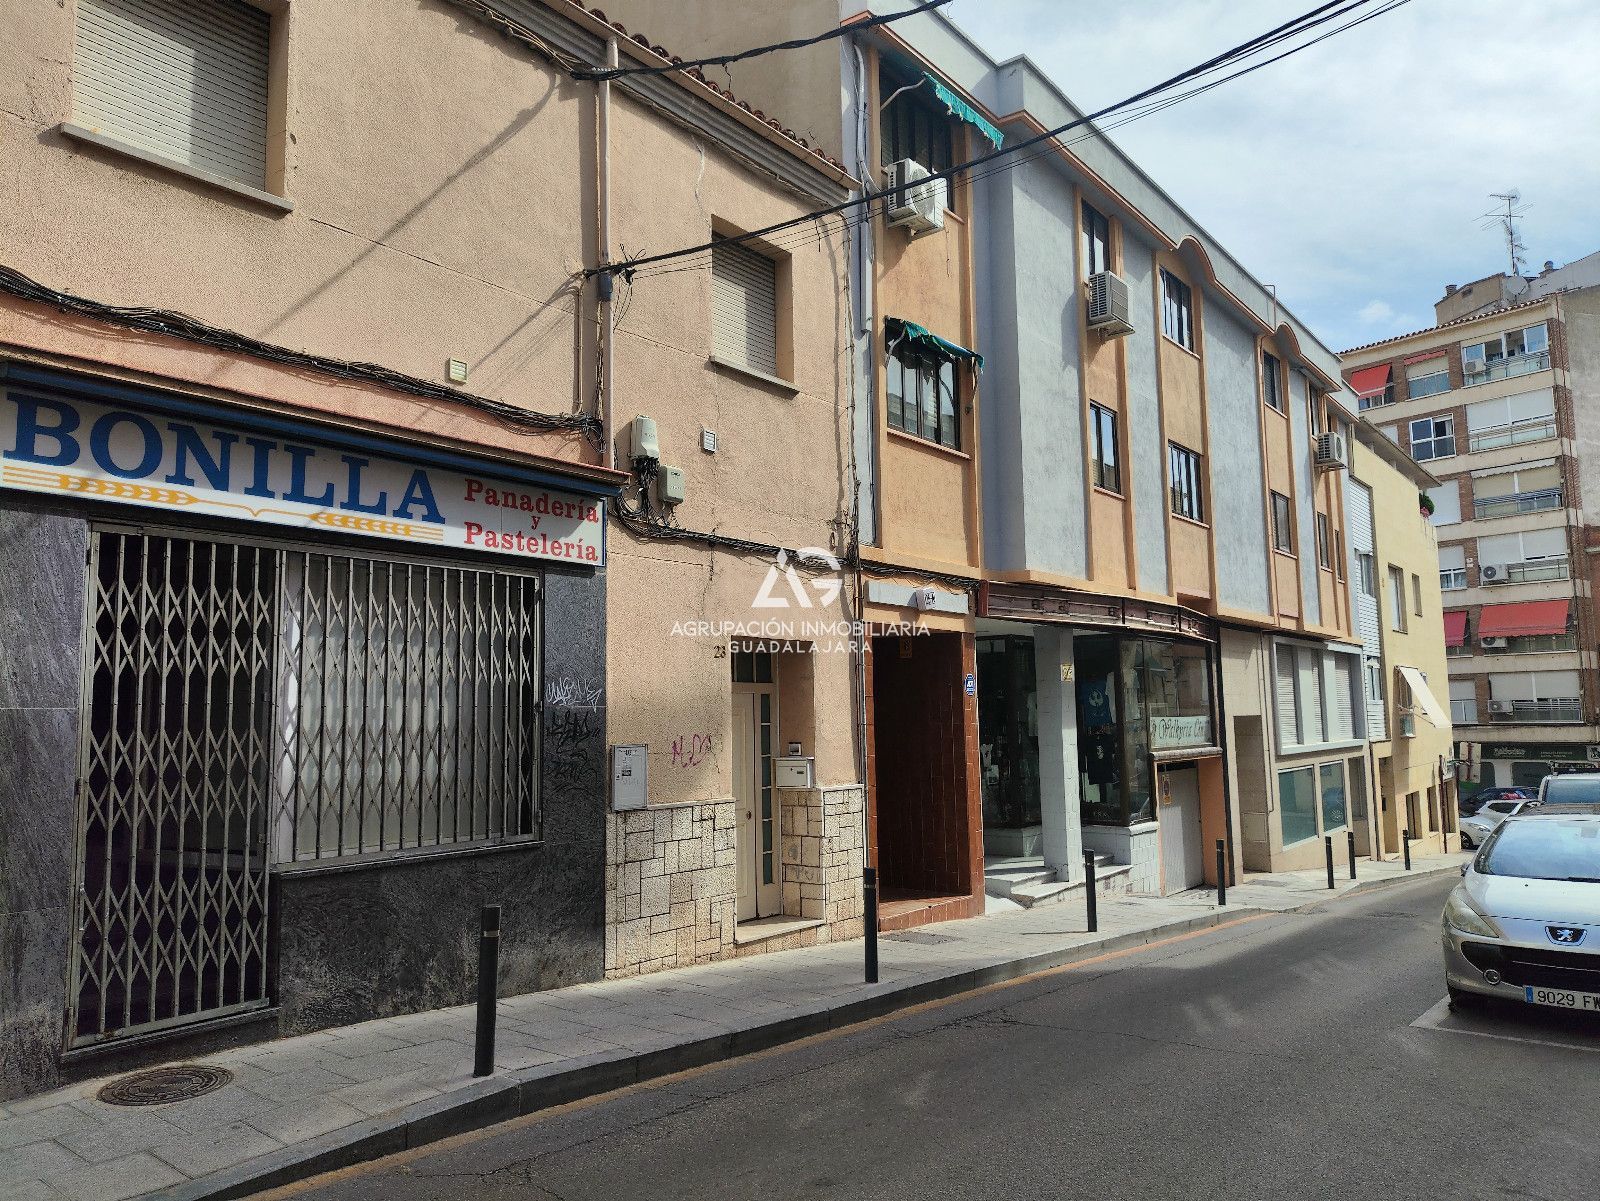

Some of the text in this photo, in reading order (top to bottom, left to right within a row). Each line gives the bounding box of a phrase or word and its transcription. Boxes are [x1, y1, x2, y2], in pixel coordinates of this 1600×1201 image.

[3, 392, 446, 525] BONILLA
[464, 477, 599, 523] Panadería
[463, 521, 599, 561] Pastelería
[531, 515, 540, 530] y
[1537, 990, 1575, 1007] 9029
